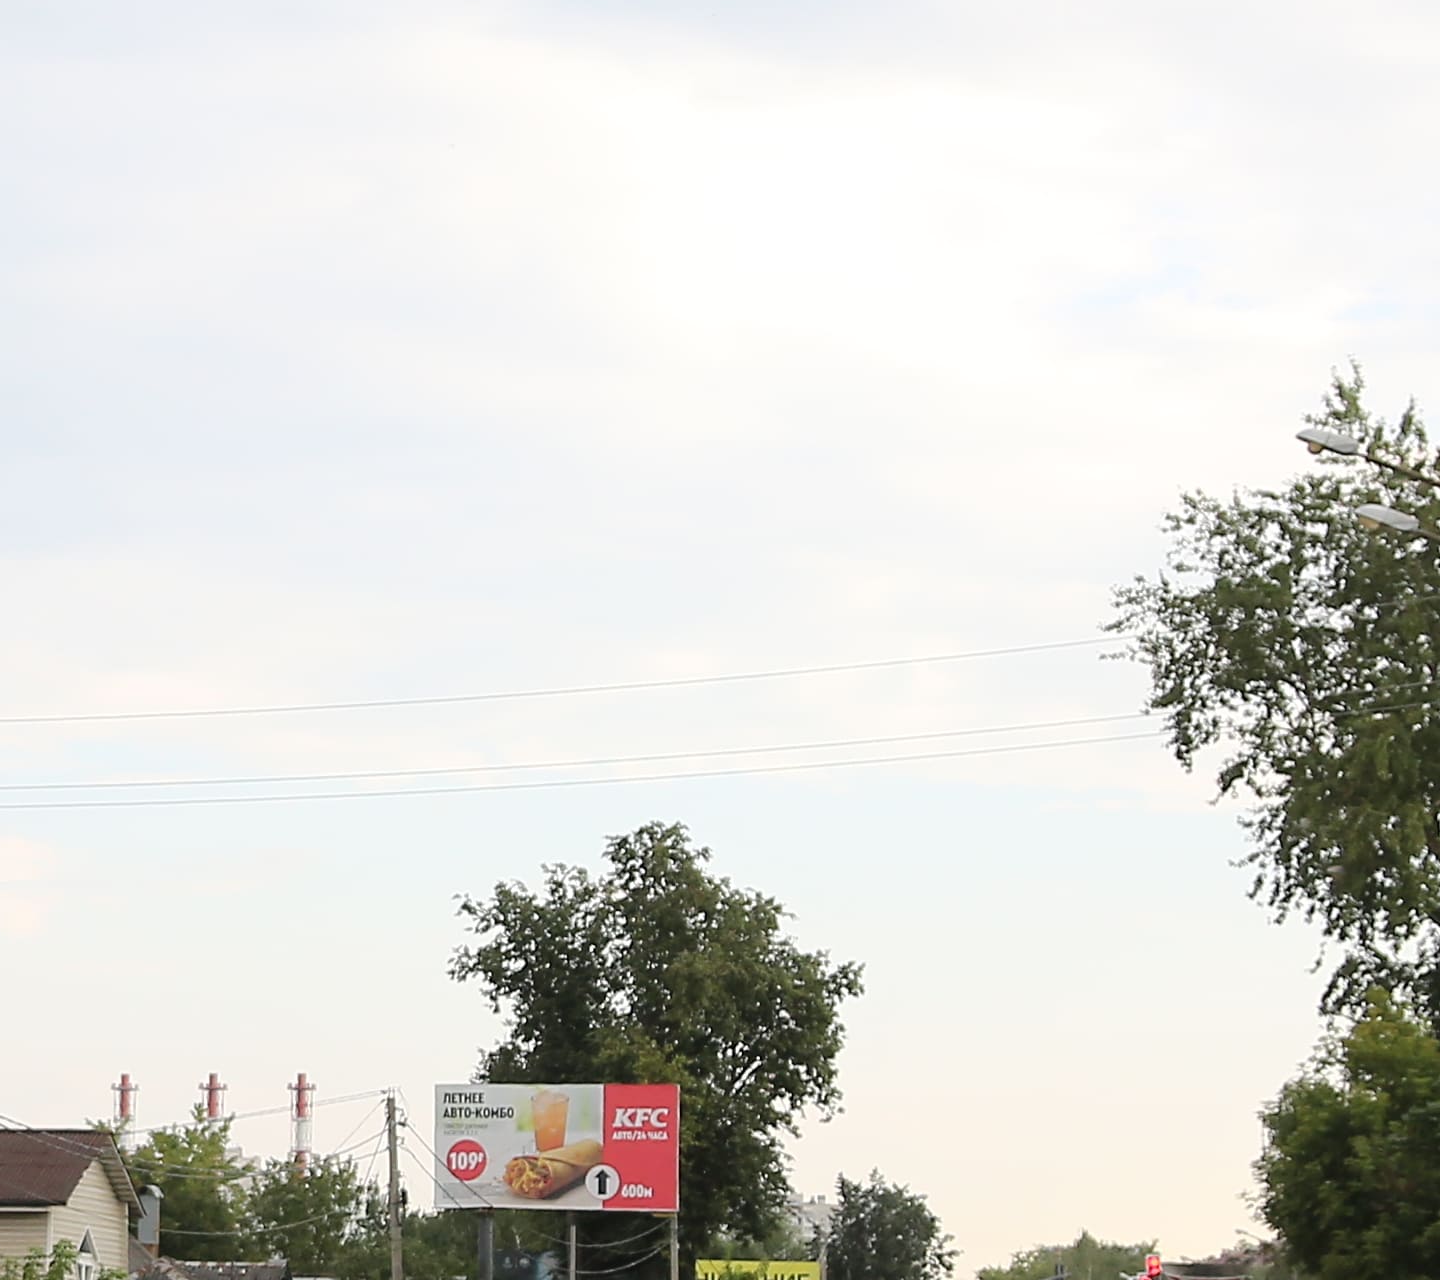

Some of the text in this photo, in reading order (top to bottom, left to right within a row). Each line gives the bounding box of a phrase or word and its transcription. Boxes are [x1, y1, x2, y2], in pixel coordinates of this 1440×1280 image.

[443, 1092, 485, 1104] ЛЕТНЕЕ
[443, 1107, 514, 1118] АВТО-КОМБО
[612, 1108, 669, 1128] KFC
